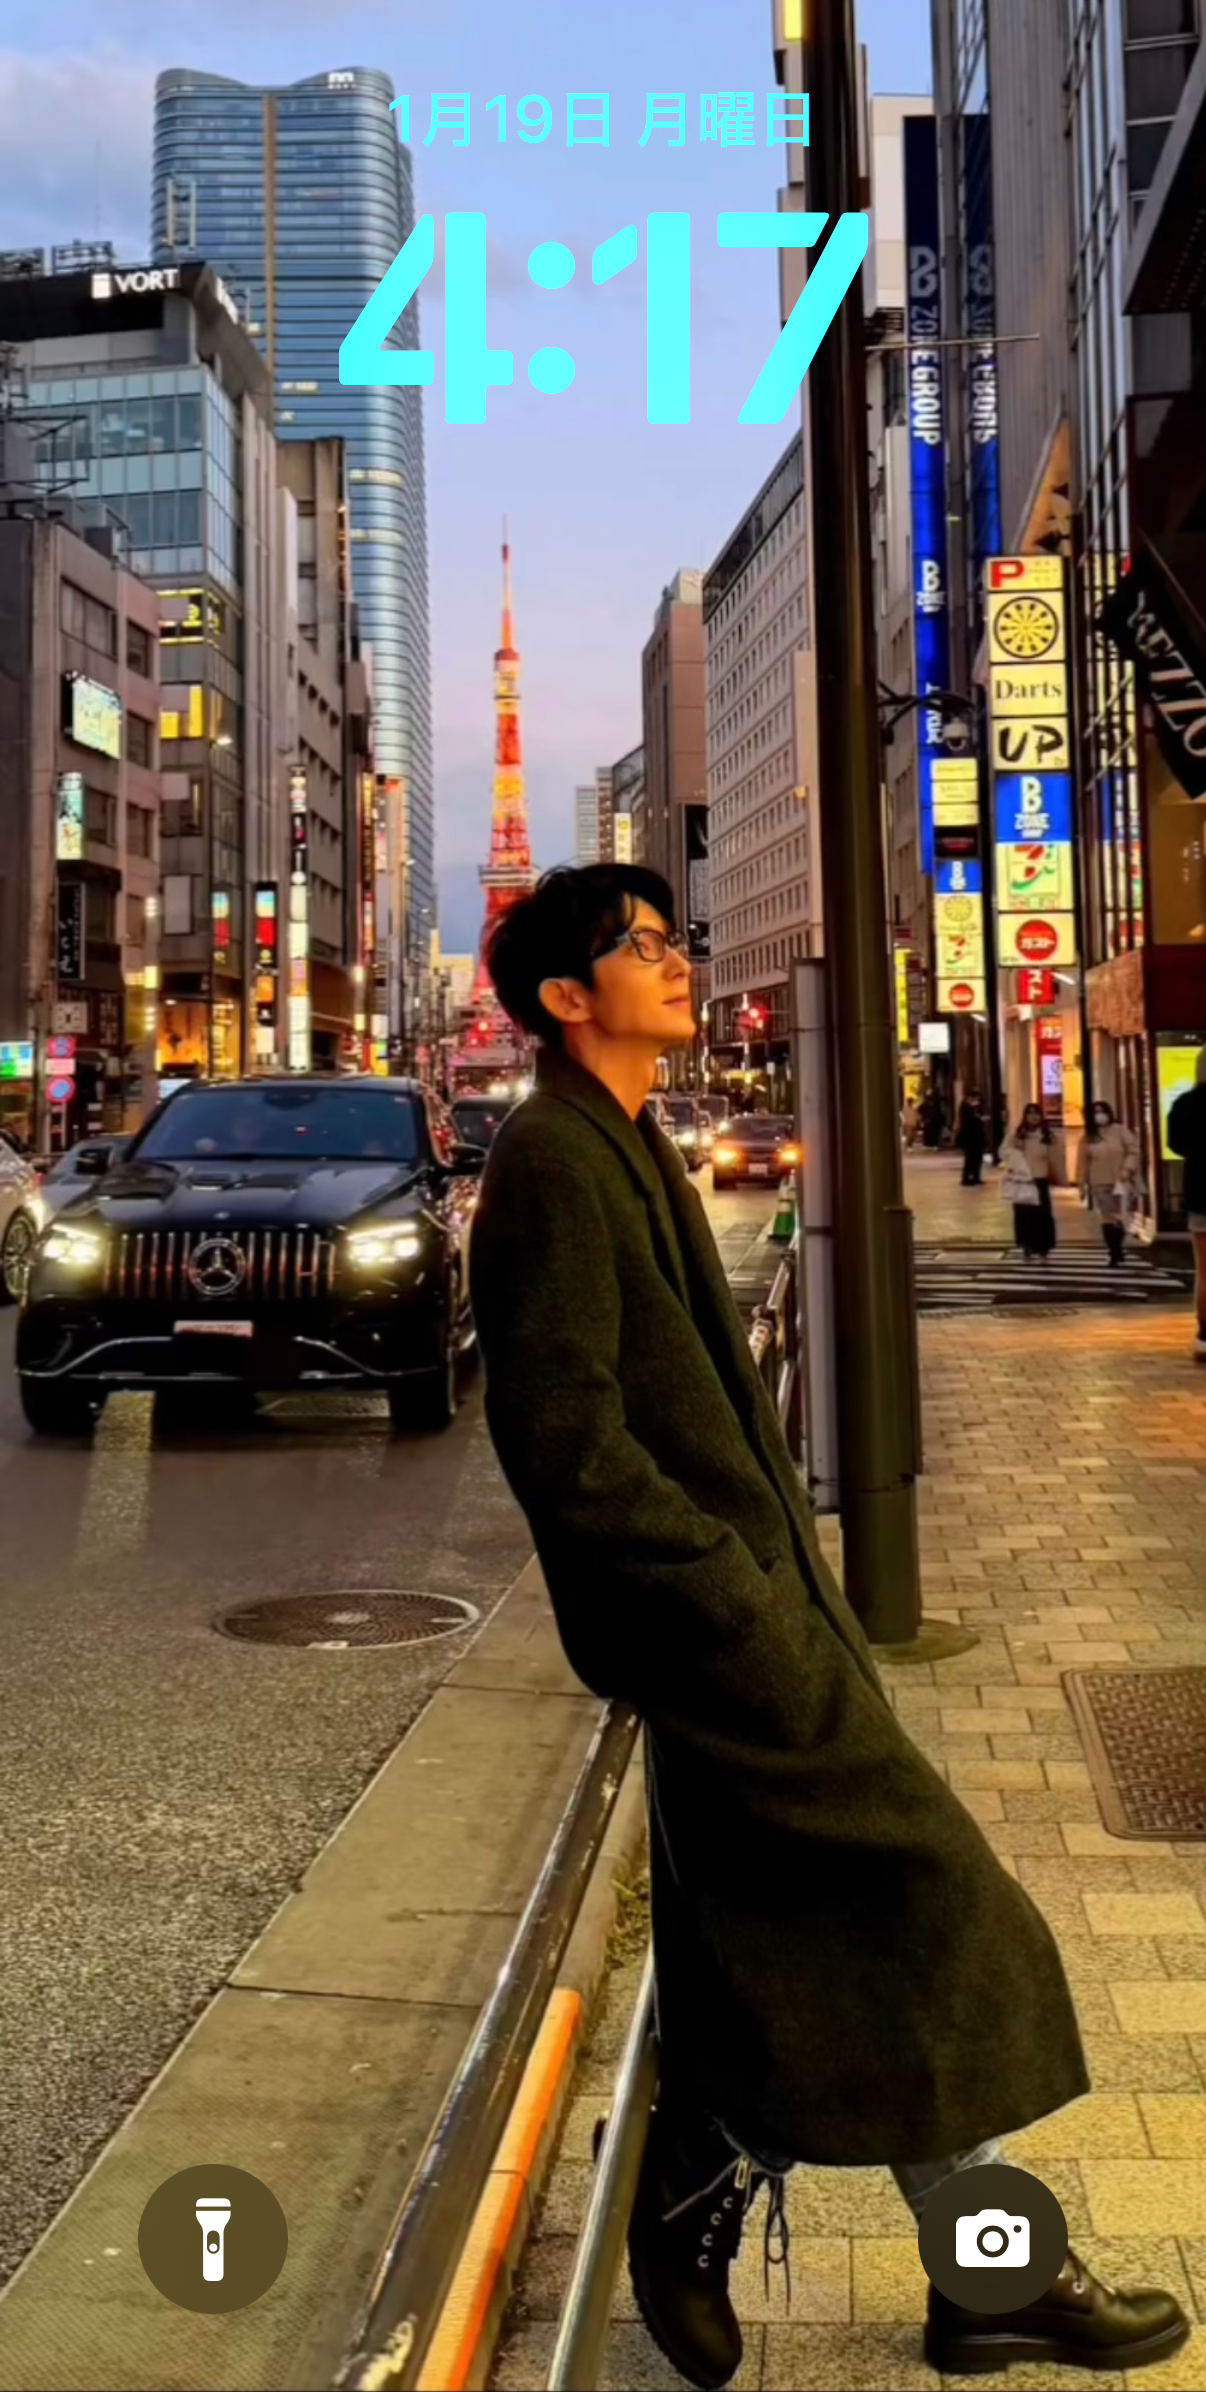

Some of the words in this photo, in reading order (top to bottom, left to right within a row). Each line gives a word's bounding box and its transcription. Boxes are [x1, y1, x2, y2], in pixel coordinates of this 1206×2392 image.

[115, 269, 179, 294] VORT
[990, 561, 1024, 588] P
[995, 679, 1062, 700] Darts
[999, 724, 1064, 764] UP
[1021, 776, 1042, 813] B
